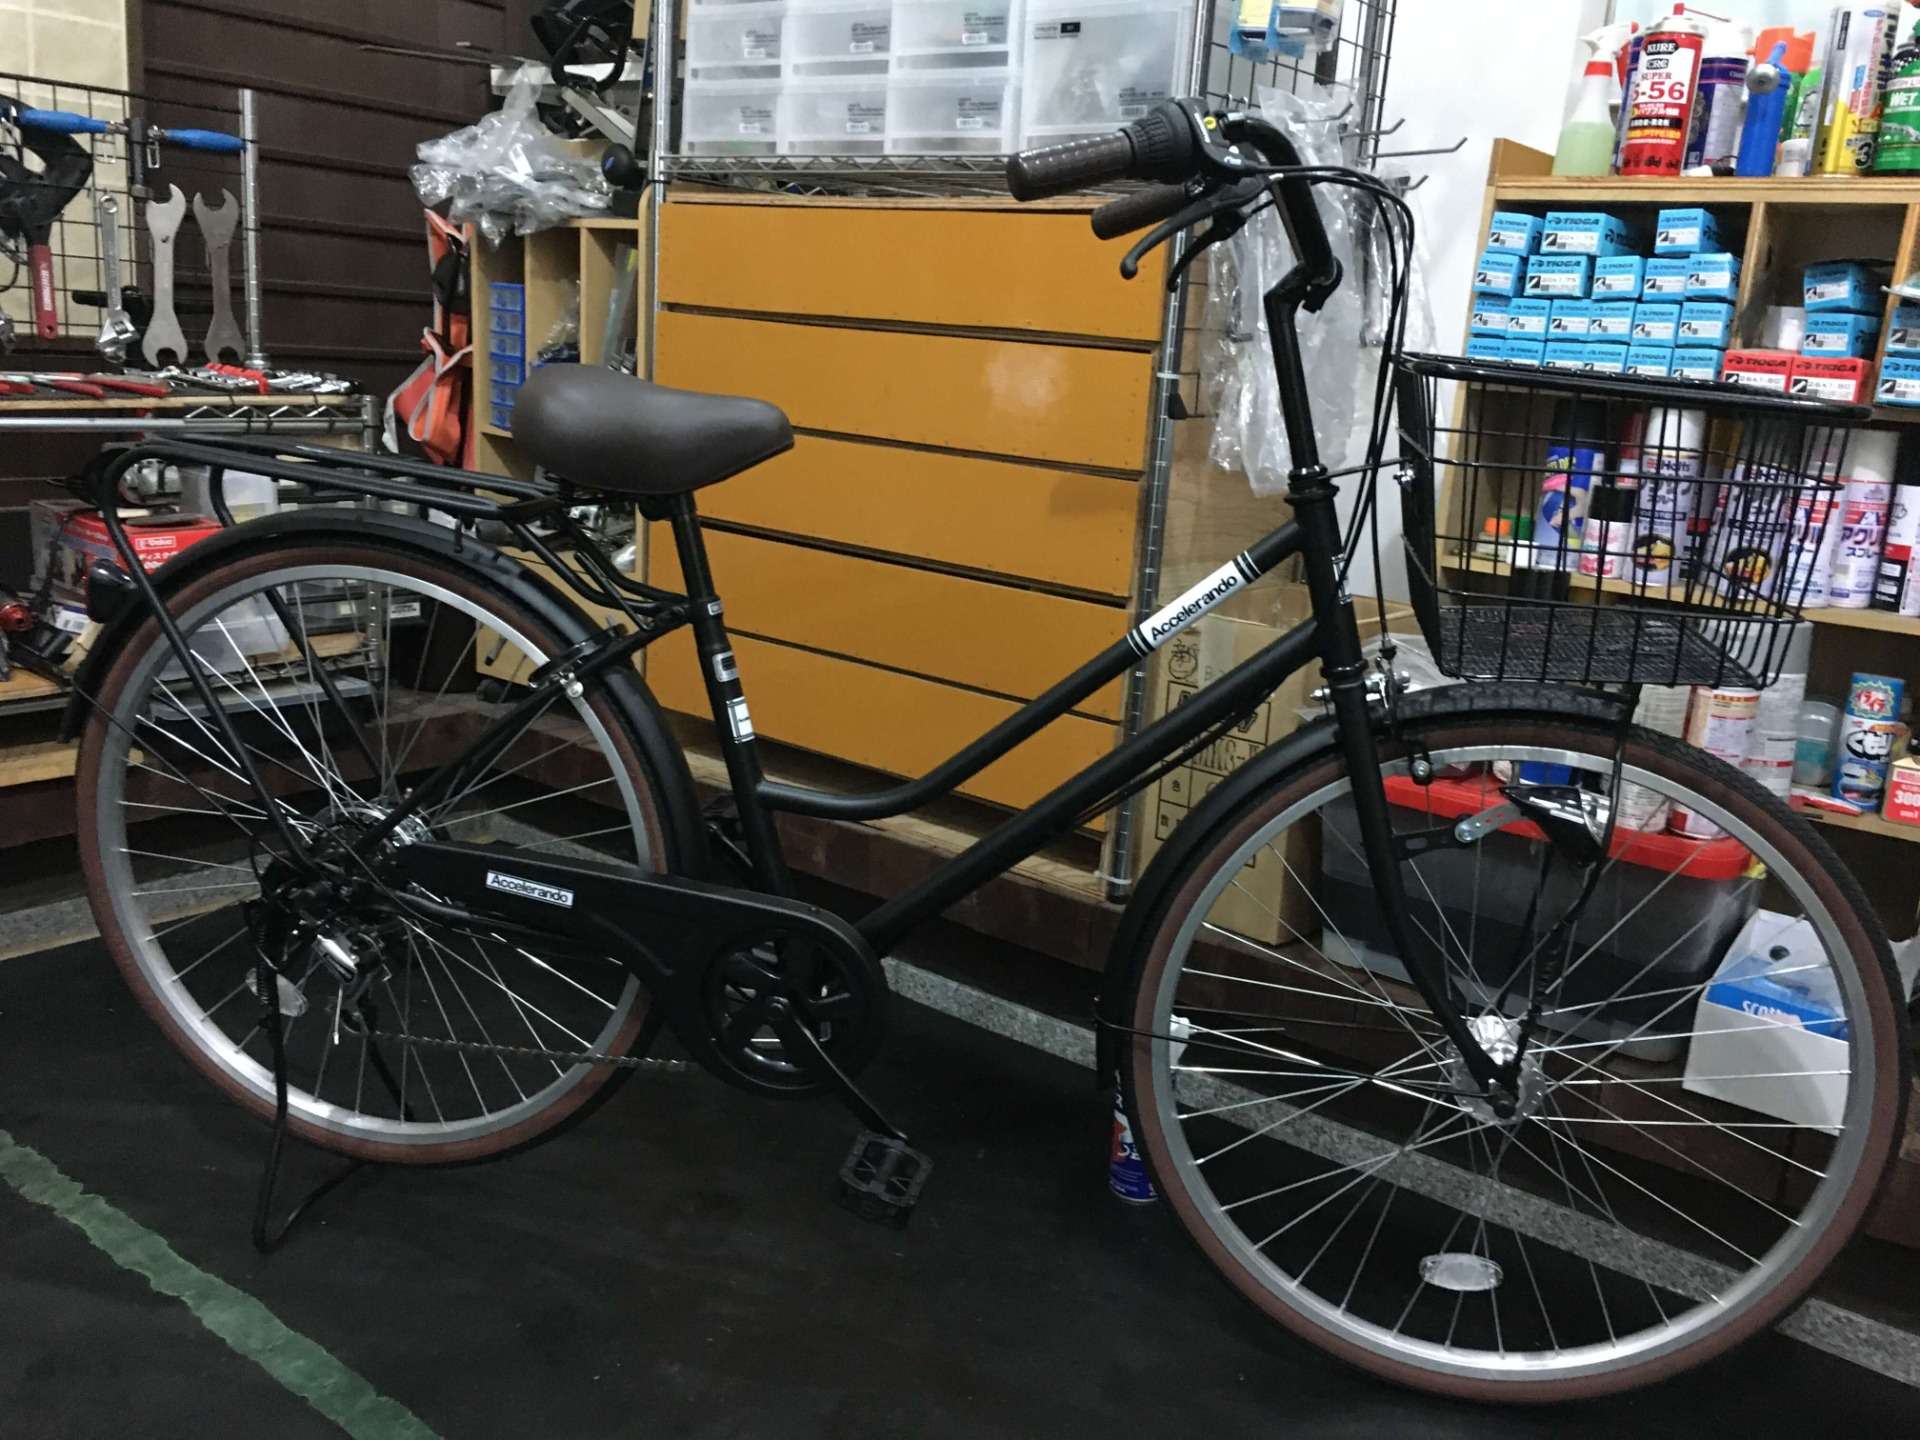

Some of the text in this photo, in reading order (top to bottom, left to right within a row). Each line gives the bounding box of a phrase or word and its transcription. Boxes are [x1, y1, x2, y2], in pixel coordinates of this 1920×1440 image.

[1647, 42, 1676, 53] KURE
[1641, 72, 1672, 80] SUPER
[1889, 92, 1918, 106] WET
[1564, 217, 1599, 225] TIOGA
[1546, 260, 1581, 268] TIOGA
[1745, 358, 1787, 368] TIOGA
[1815, 364, 1857, 373] TIOGA
[1150, 575, 1238, 641] Accelerando
[491, 874, 569, 903] Accelerando
